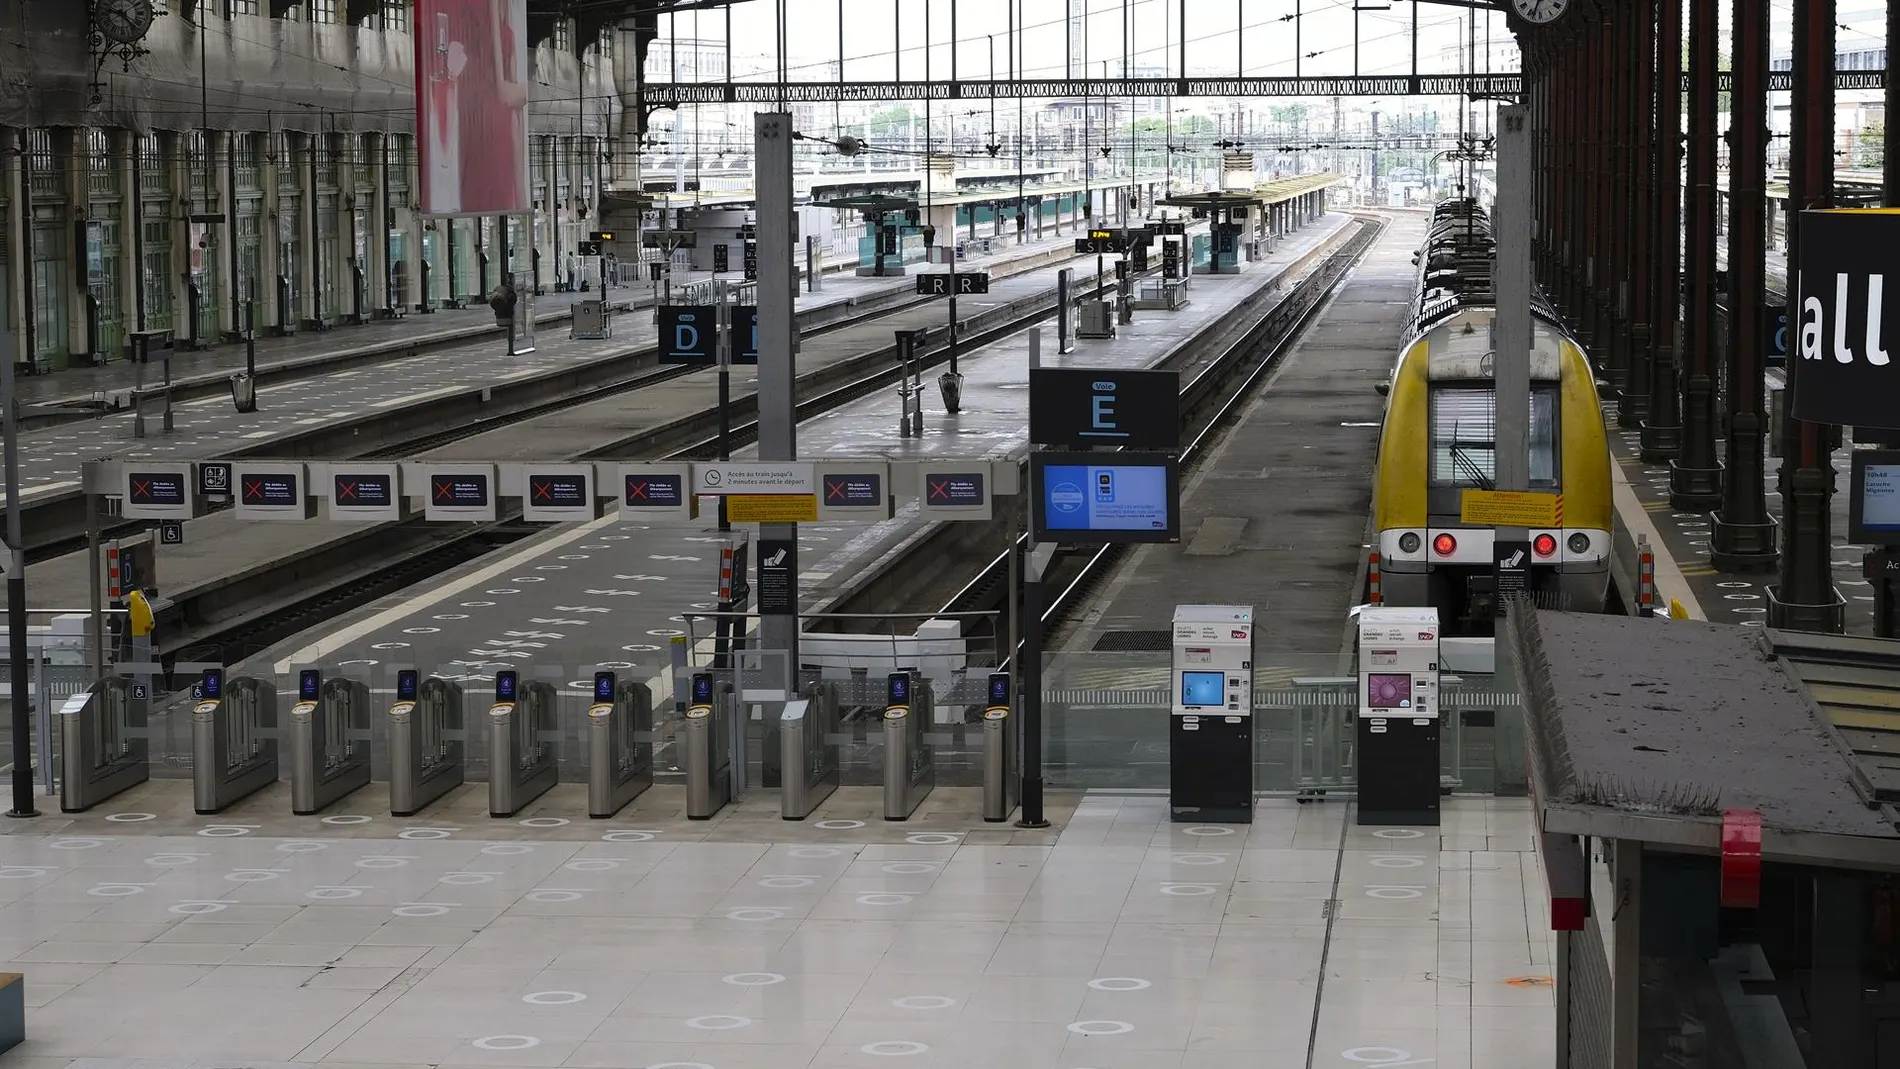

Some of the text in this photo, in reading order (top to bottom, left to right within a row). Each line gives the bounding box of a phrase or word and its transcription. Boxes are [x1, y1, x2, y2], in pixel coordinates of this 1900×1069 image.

[590, 244, 597, 254] S
[1087, 242, 1094, 252] S
[1107, 242, 1114, 252] S
[933, 278, 944, 292] R
[961, 278, 972, 292] R
[1796, 271, 1890, 366] all
[676, 324, 698, 350] D
[1092, 395, 1116, 429] E
